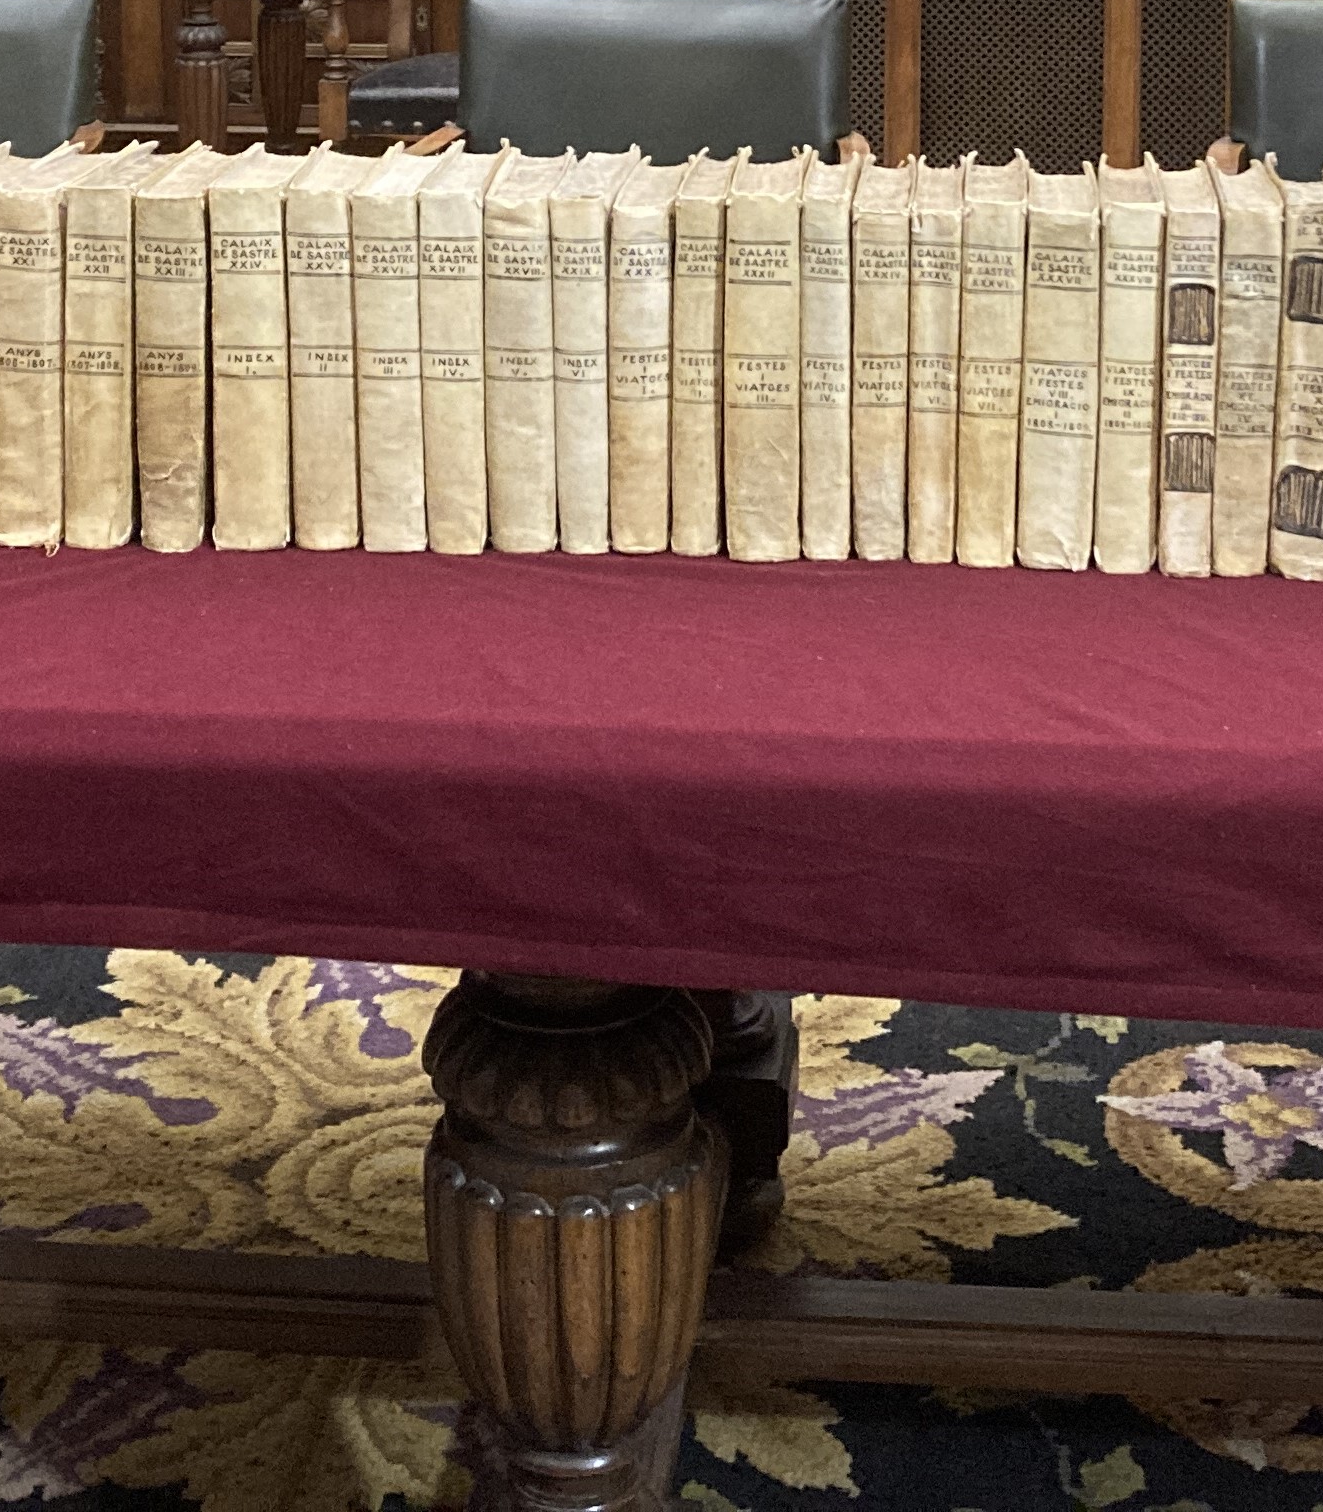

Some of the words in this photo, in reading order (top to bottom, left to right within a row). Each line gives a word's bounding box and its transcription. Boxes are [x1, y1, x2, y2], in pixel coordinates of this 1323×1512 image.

[220, 239, 273, 248] CALAIX
[297, 241, 347, 250] CALAIX
[363, 244, 413, 253] CALAIX
[425, 244, 475, 254] CALAIX
[738, 248, 787, 257] CALAIX
[232, 249, 278, 259] SASTRE
[744, 258, 789, 268] SASTRE
